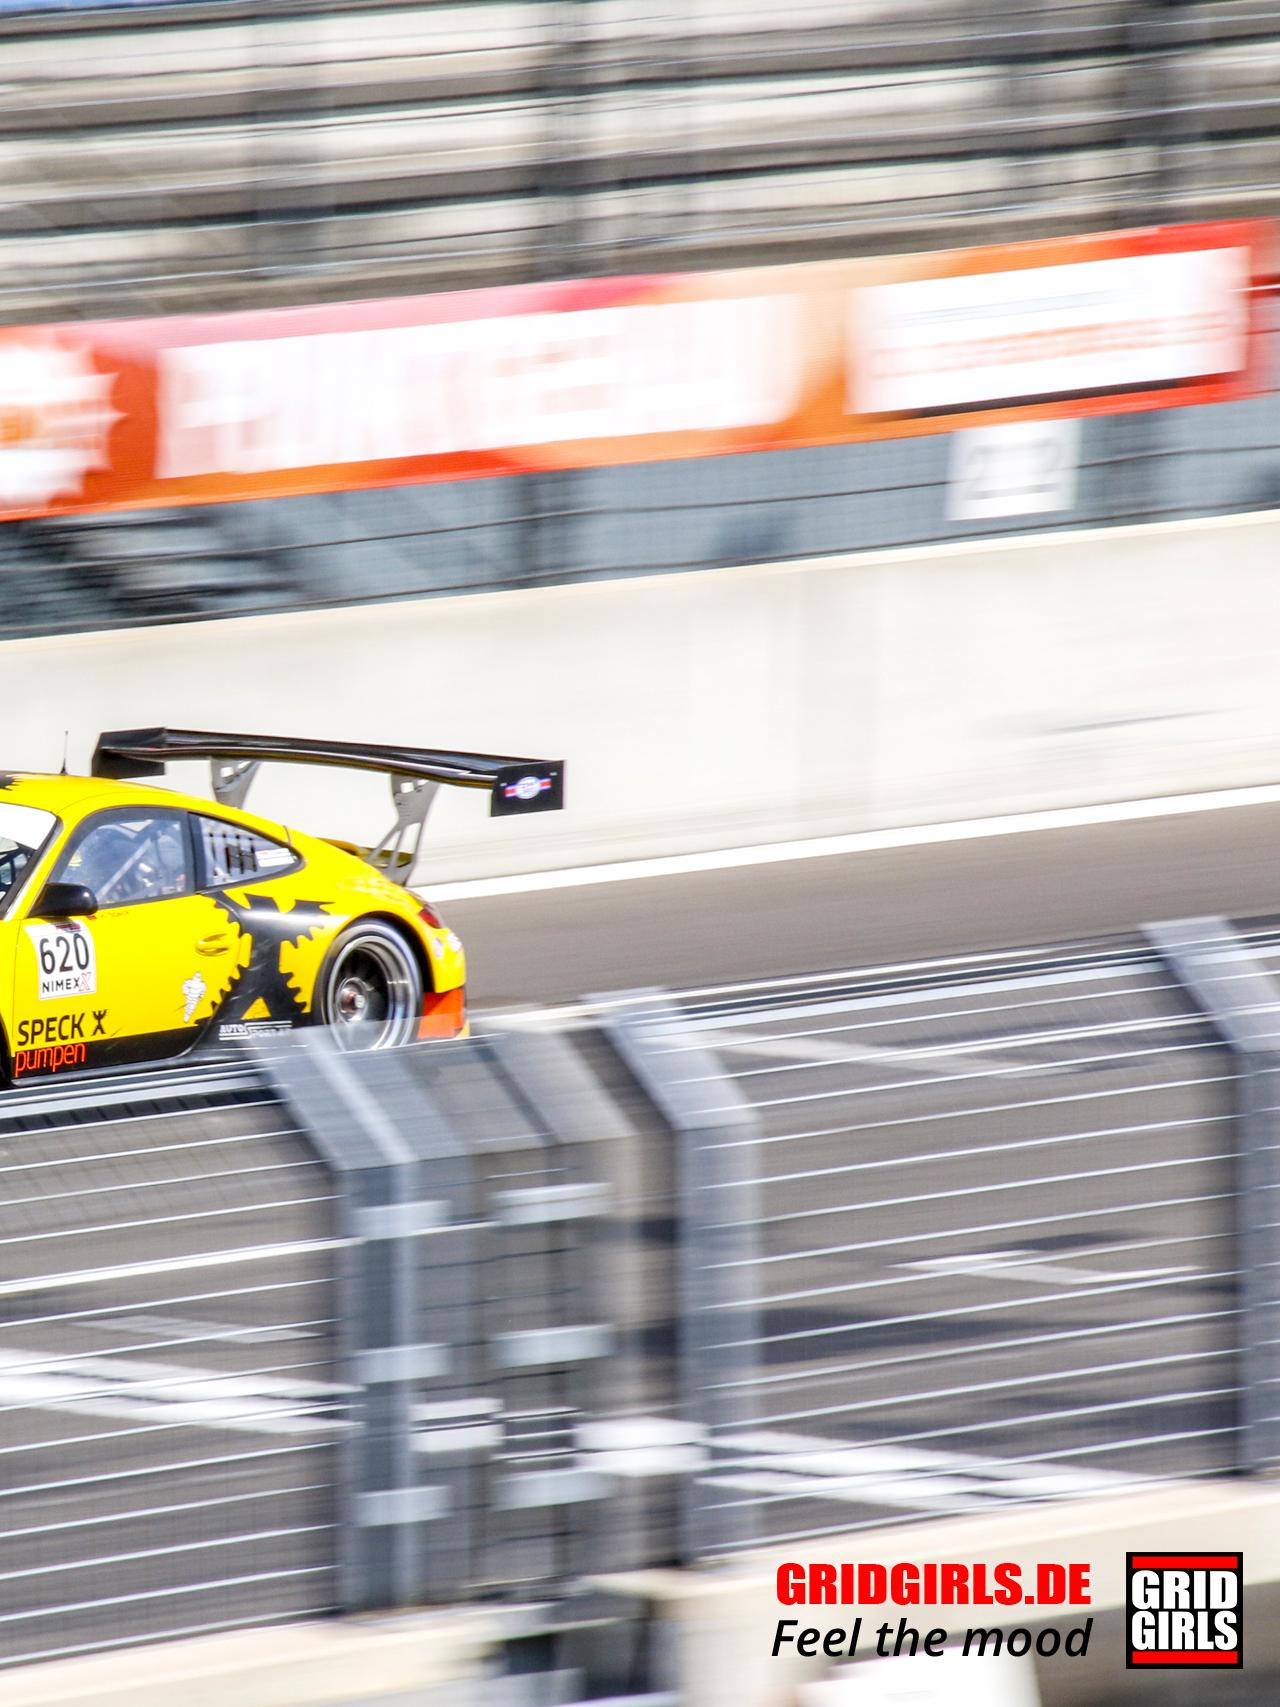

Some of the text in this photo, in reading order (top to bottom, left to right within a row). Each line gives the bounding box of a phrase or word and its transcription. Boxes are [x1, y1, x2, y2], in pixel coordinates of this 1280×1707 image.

[39, 933, 90, 975] 620
[17, 1012, 85, 1046] SPECK
[219, 1024, 246, 1034] AUTO
[15, 1043, 86, 1078] pumpen
